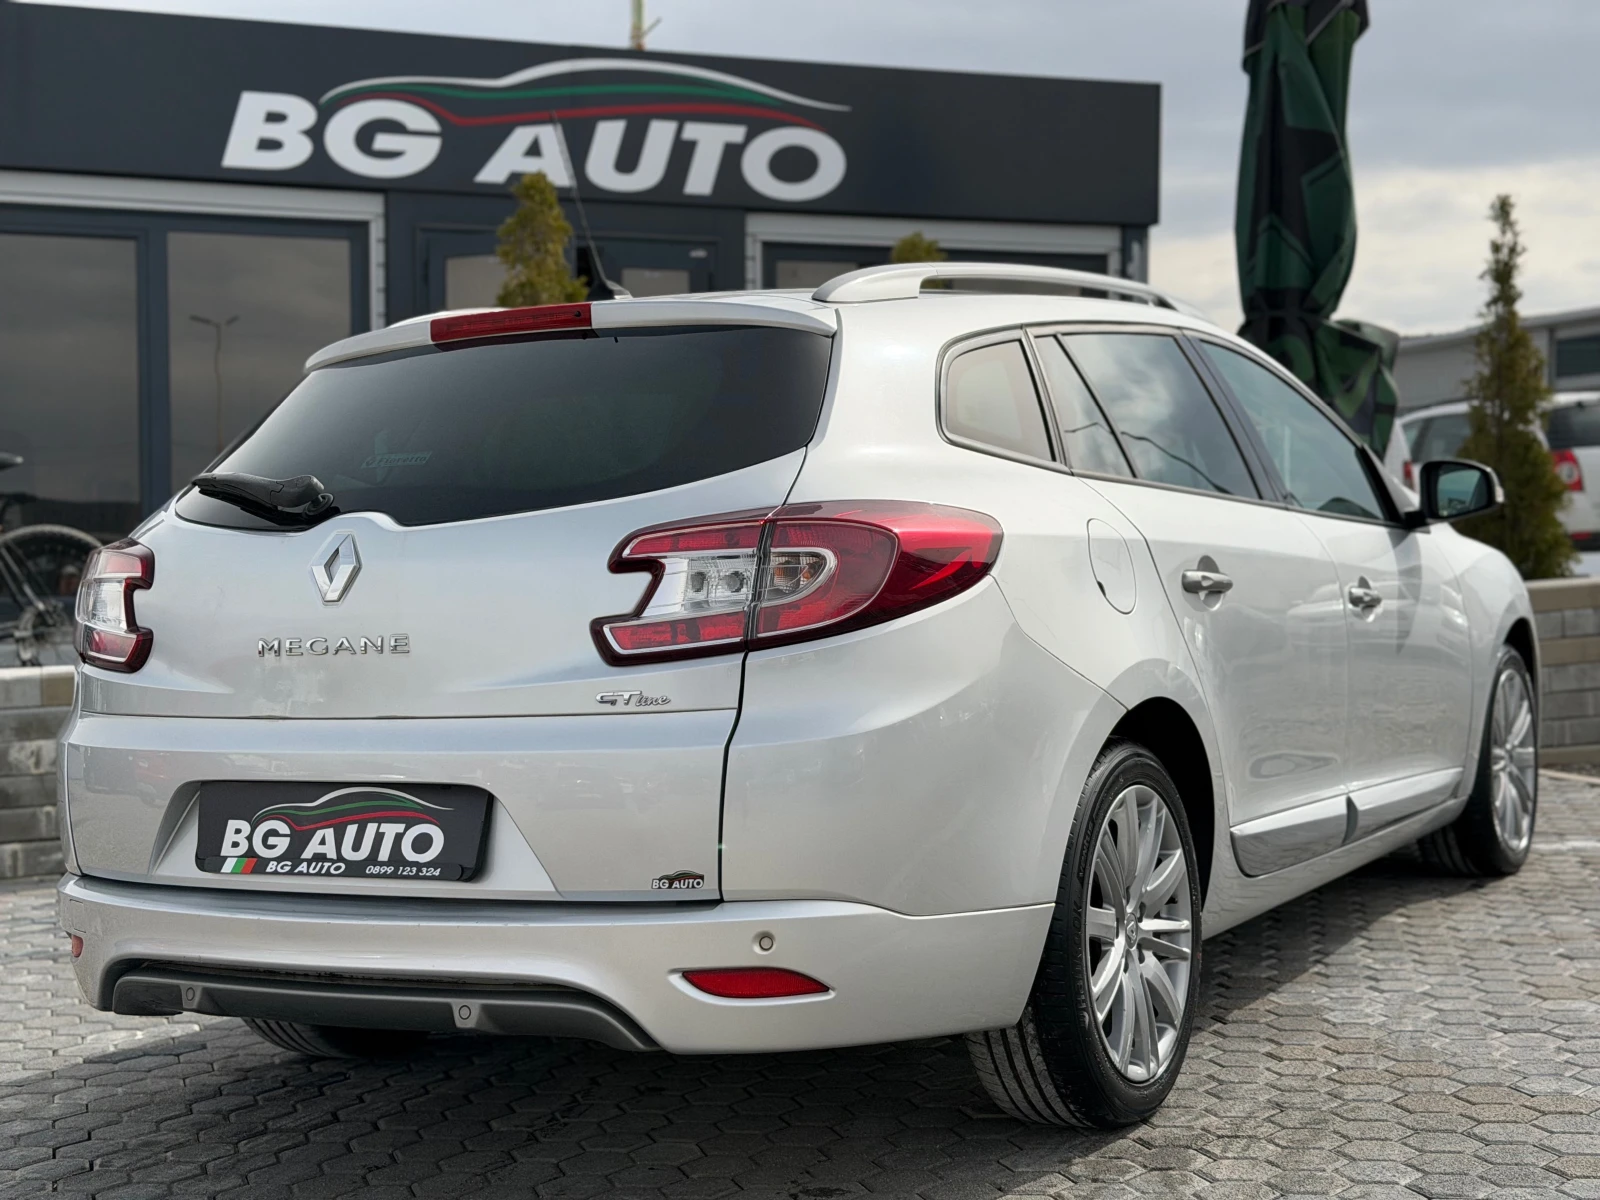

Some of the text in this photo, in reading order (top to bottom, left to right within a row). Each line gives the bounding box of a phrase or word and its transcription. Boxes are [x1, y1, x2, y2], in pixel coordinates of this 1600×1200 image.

[221, 90, 847, 201] BG AUTO
[257, 633, 411, 657] MEGANE
[220, 819, 445, 863] BG AUTO
[265, 860, 442, 877] BG AUTO 0899 123 324
[652, 878, 704, 889] BG AUTO
